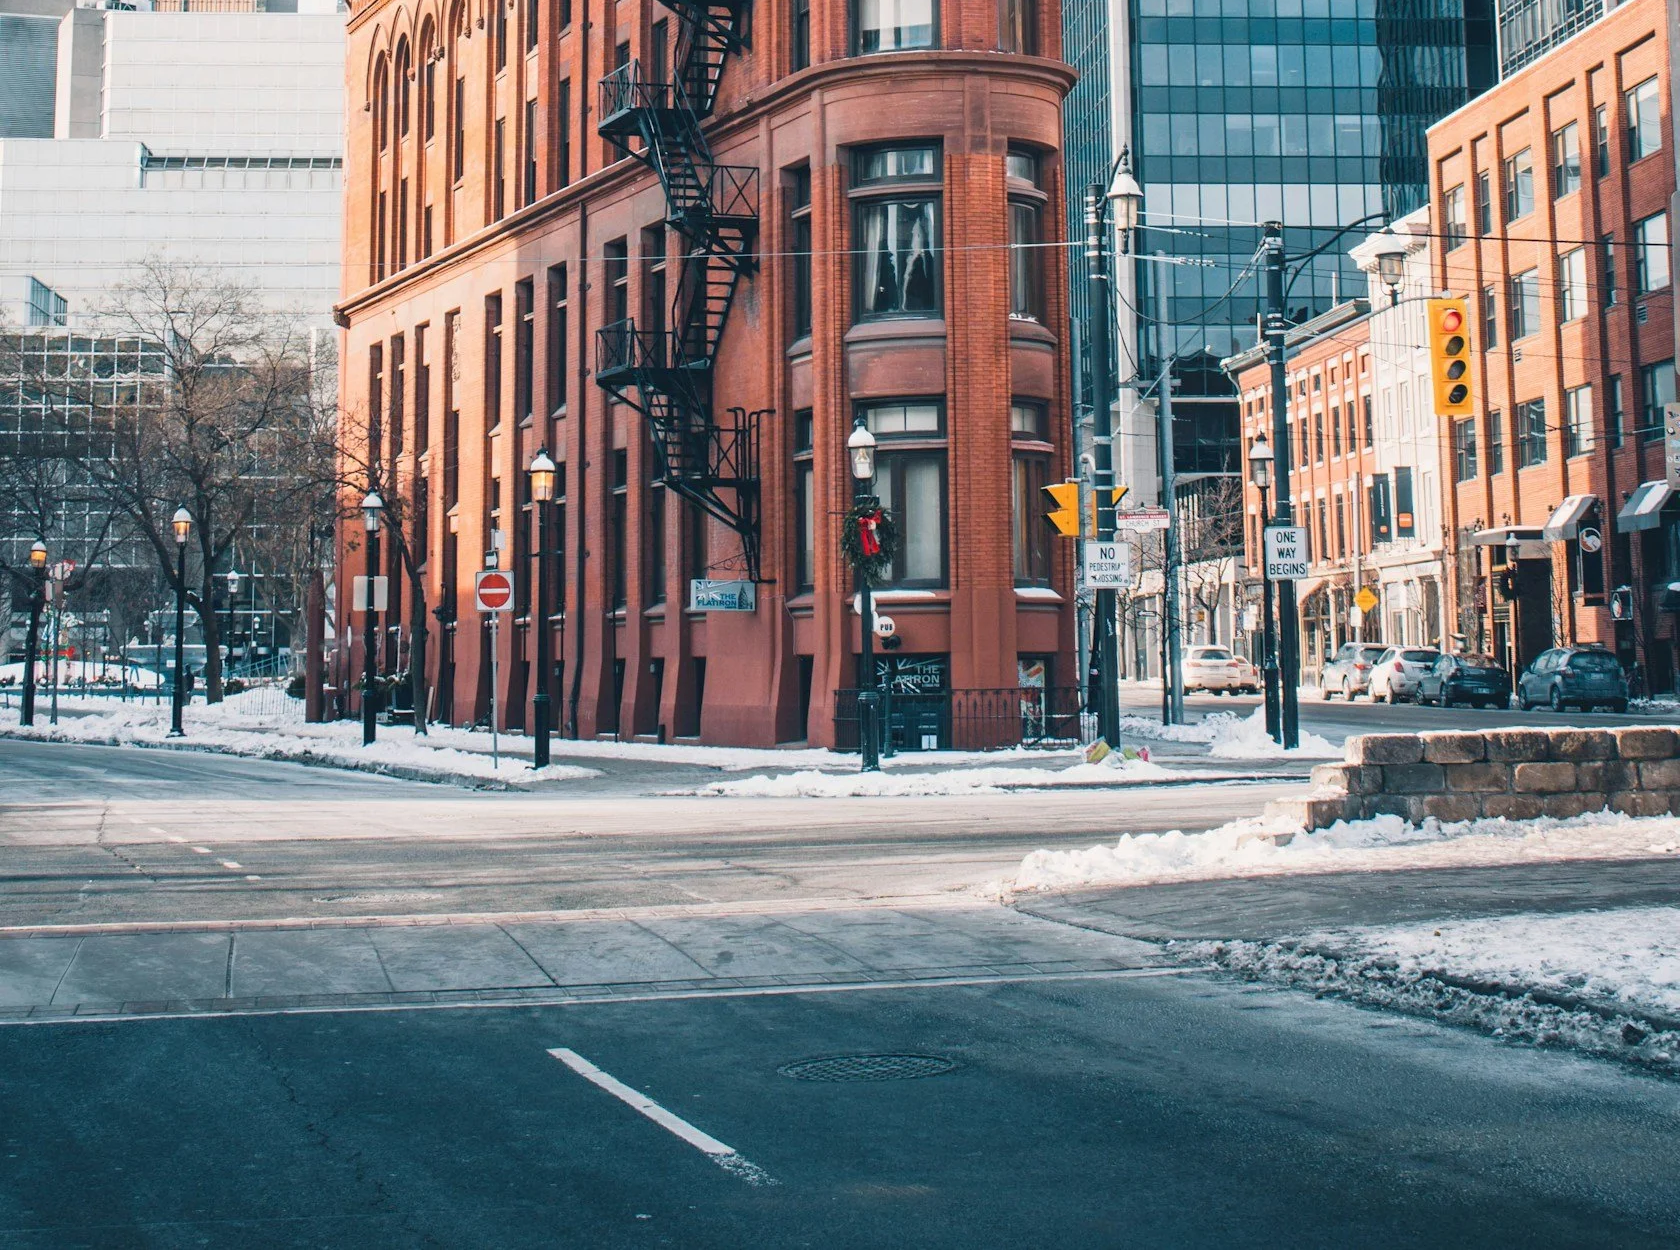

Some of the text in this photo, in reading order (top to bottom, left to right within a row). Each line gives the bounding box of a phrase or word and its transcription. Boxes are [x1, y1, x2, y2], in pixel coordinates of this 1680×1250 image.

[1276, 531, 1296, 543] ONE
[1100, 547, 1115, 559] NO
[1277, 547, 1296, 559] WAY
[1269, 563, 1306, 575] BEGINS
[880, 623, 893, 631] PUB
[916, 665, 940, 674] THE
[881, 674, 940, 684] FATIRON
